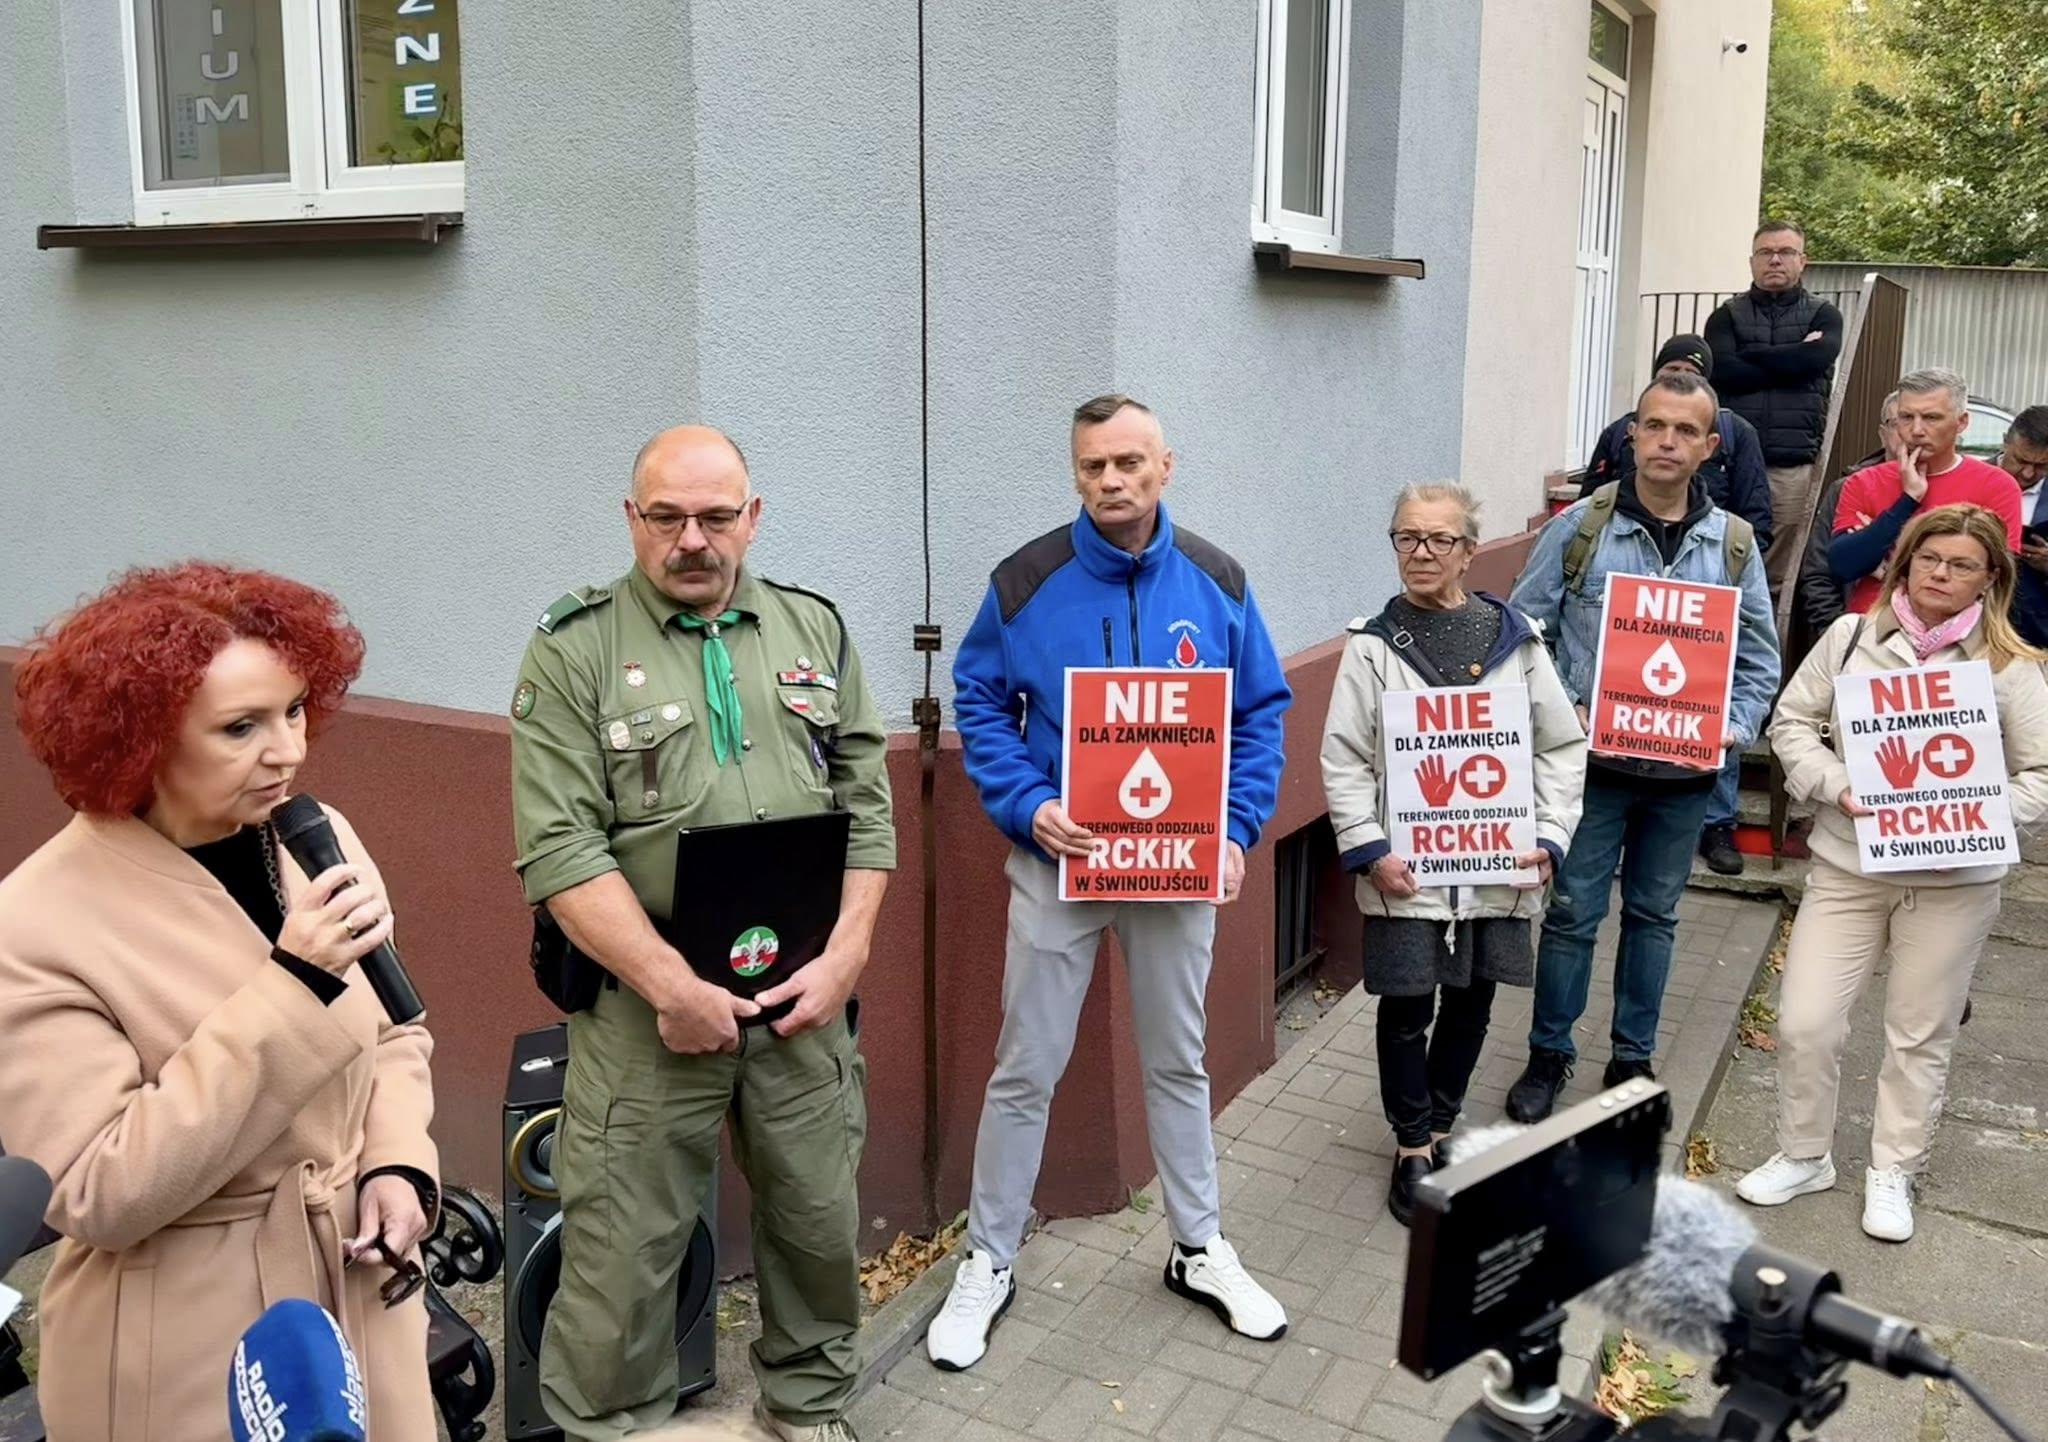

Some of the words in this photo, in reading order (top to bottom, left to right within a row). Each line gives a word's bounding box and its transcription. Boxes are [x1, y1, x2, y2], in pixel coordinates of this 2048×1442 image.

[1635, 585, 1706, 625] NIE
[1613, 617, 1638, 633] DLA
[1642, 621, 1725, 644] ZAMKNIĘCIA
[1105, 681, 1189, 724] NIE
[1603, 690, 1668, 708] TERENOWEGO
[1671, 700, 1720, 715] ODDZIAŁU
[1870, 670, 1955, 714] NIE
[1416, 692, 1492, 732] NIE
[1612, 704, 1704, 741] RCKiK
[1852, 720, 1882, 735] DLA
[1886, 708, 1987, 731] ZAMKNIĘCIA
[1079, 728, 1109, 743] DLA
[1115, 727, 1216, 747] ZAMKNIĘCIA
[1395, 736, 1423, 751] DLA
[1428, 731, 1520, 750] ZAMKNIĘCIA
[1600, 733, 1614, 745] W
[1616, 732, 1712, 760] ŚWINOUJŚCIU
[1860, 789, 1938, 806] TERENOWEGO
[1942, 785, 2001, 800] ODDZIAŁU
[1076, 822, 1152, 834] ERENOWEGO
[1157, 822, 1214, 834] ODDZIAŁU
[1397, 809, 1470, 823] TERENOWEGO
[1474, 807, 1528, 820] ODDZIAŁU
[1877, 801, 1988, 837] RCKiK
[1412, 822, 1513, 854] RCKiK
[1869, 844, 1885, 858] W
[1890, 835, 2006, 858] ŚWINOUJŚCIU
[1087, 838, 1196, 870] RCKiK
[1422, 854, 1517, 873] ŚWINOUJŚCI
[1075, 875, 1092, 891] W
[1095, 872, 1208, 891] ŚWINOUJŚCIU
[248, 1360, 288, 1442] RADIO
